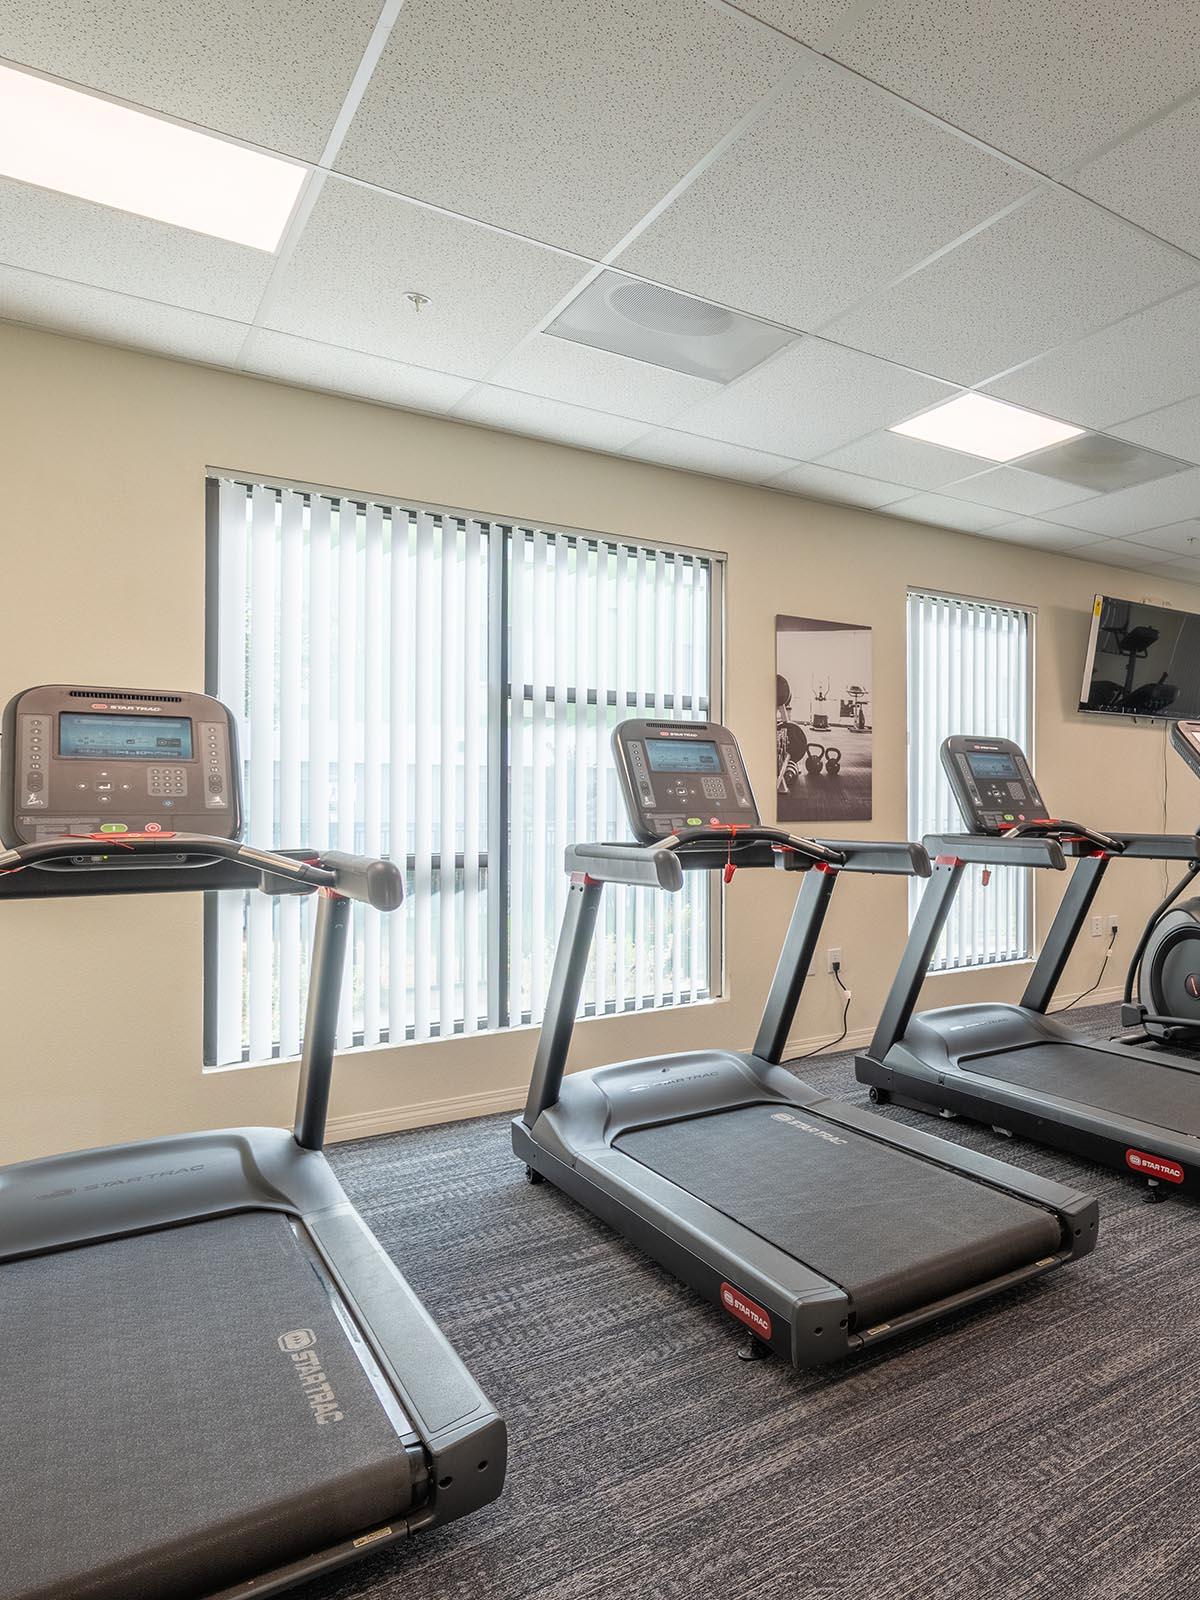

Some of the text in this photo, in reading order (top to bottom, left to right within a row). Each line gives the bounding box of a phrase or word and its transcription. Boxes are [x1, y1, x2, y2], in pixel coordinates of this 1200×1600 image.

[1142, 1159, 1182, 1178] STAR TRAC
[734, 1299, 769, 1330] STAR TRAC
